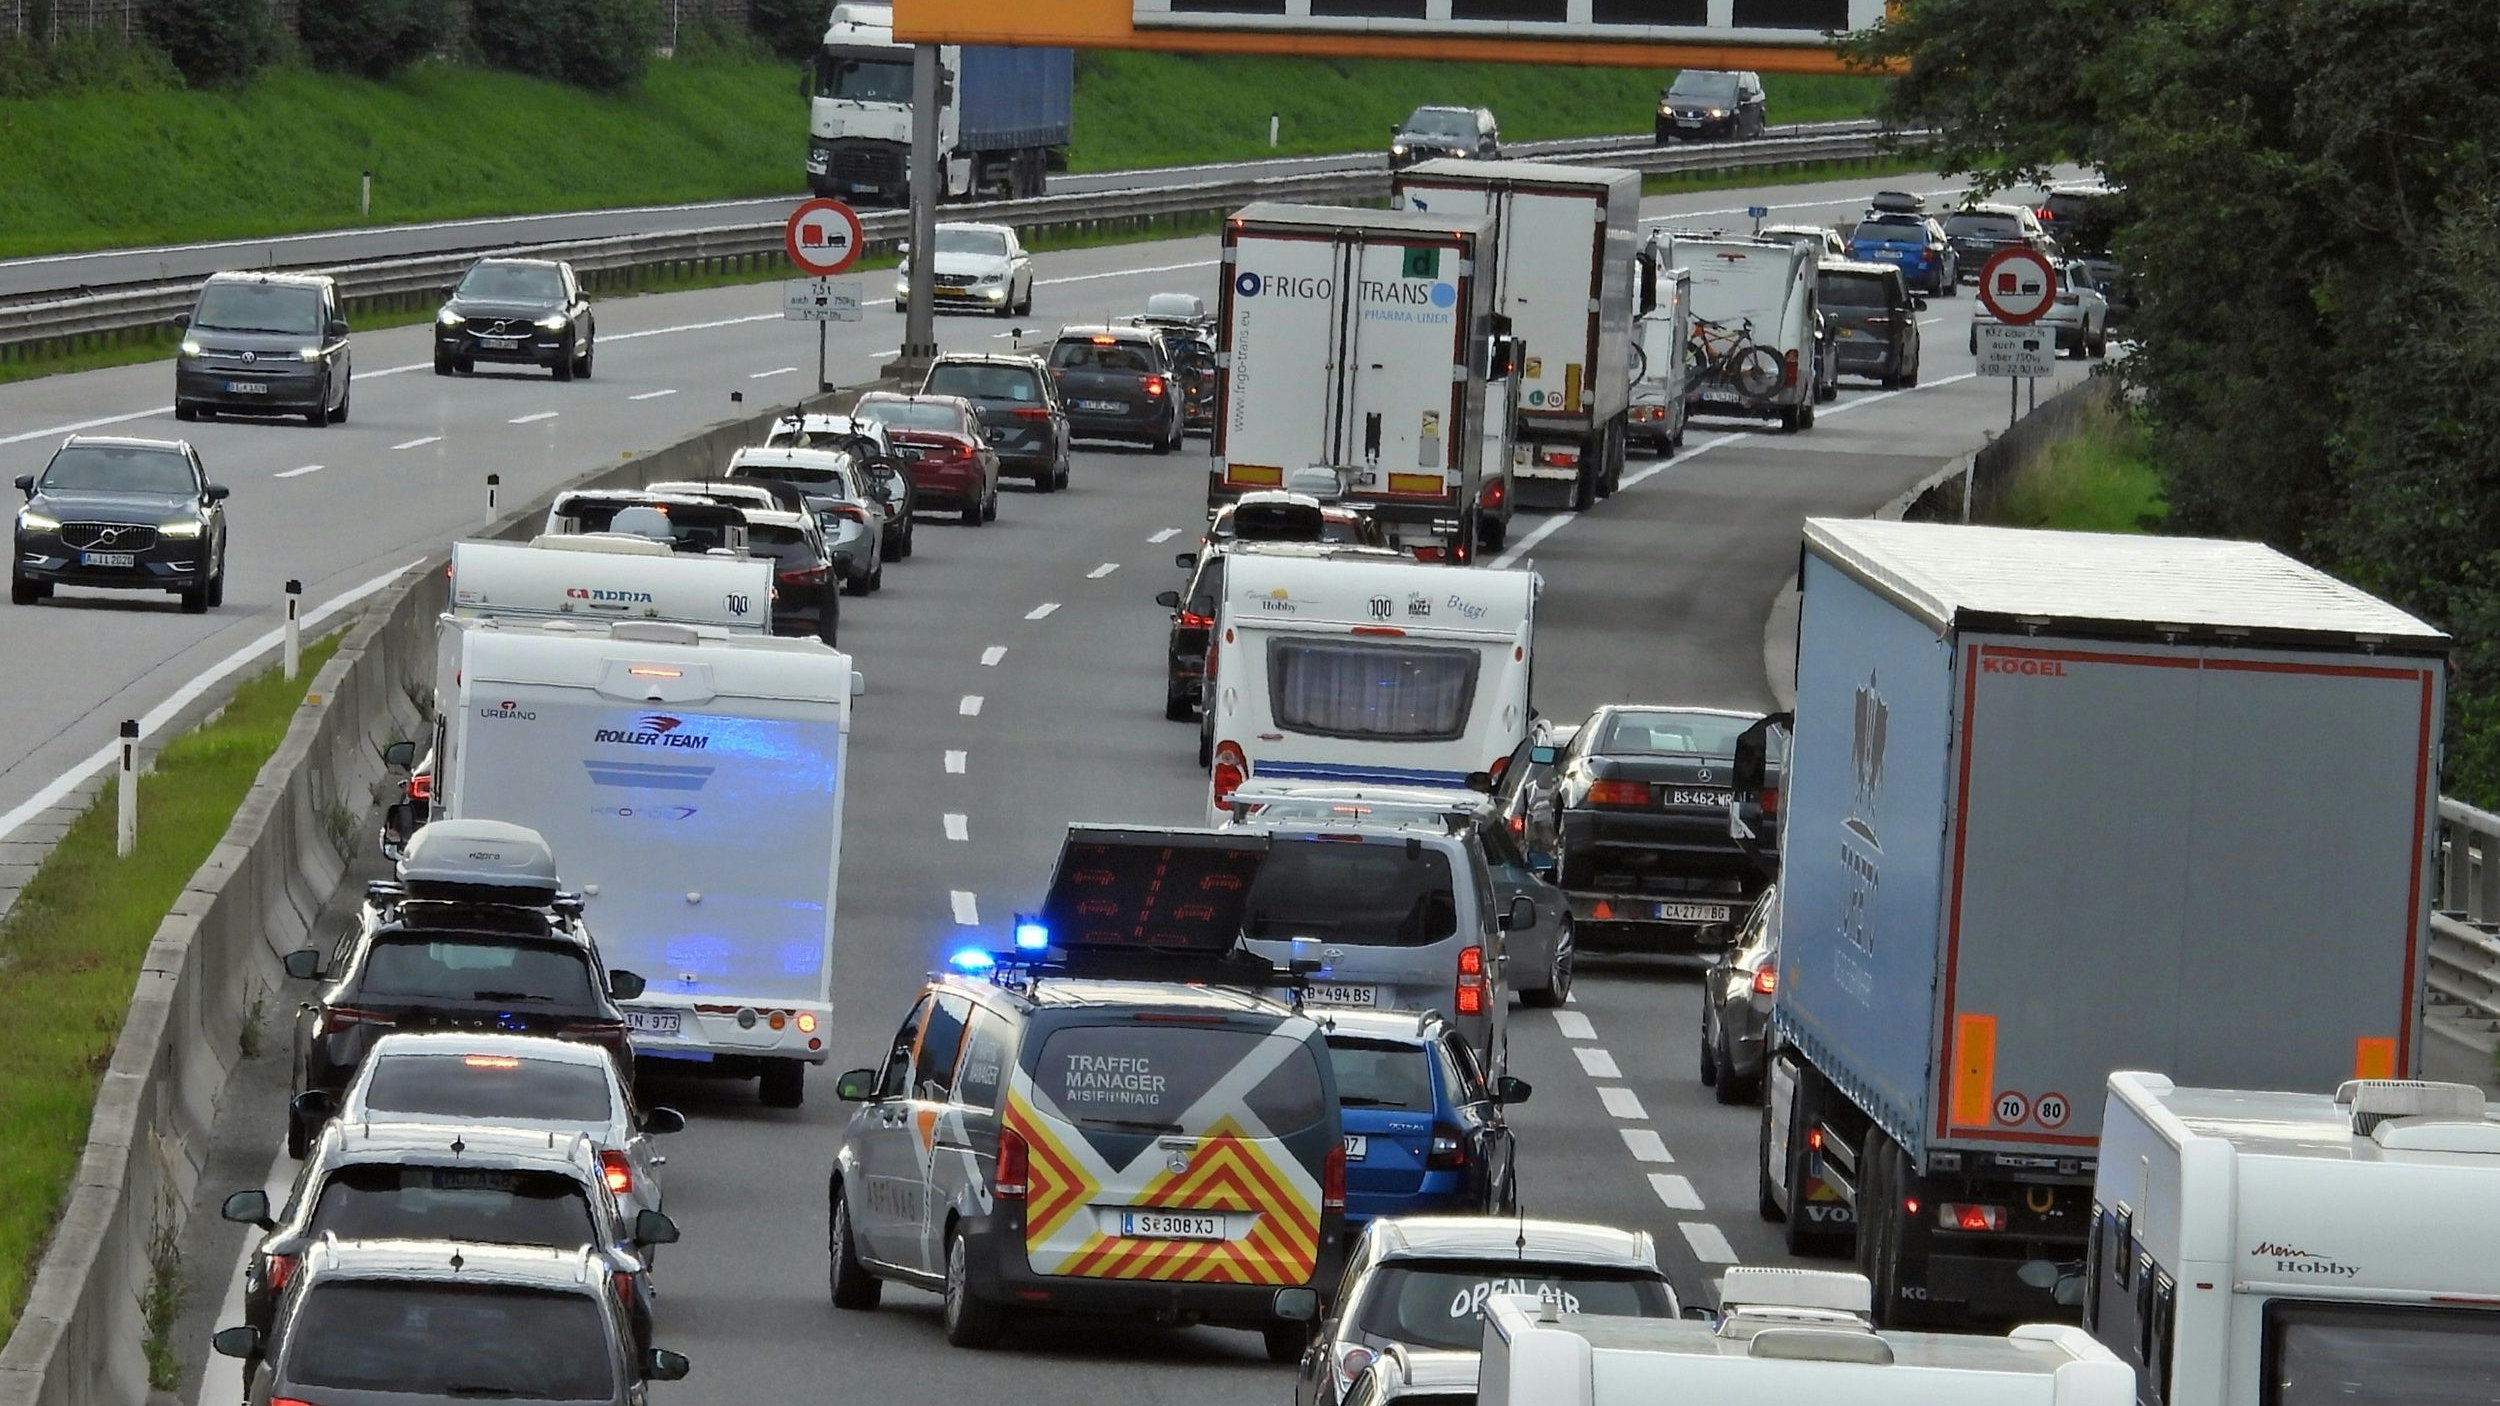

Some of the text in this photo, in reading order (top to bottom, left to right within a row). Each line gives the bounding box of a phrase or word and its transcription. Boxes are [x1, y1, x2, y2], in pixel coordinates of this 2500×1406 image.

[1262, 275, 1429, 305] FRIGO TRANS
[1233, 310, 1250, 433] www.frigo-trans.eu
[592, 590, 653, 603] ADRIA
[727, 594, 748, 616] 100
[1262, 600, 1298, 614] Hobby
[1370, 599, 1392, 617] 100
[481, 708, 537, 721] URBANO
[594, 729, 709, 749] ROLLER TEAM
[1066, 1054, 1150, 1073] TRAFFIC
[1065, 1072, 1166, 1092] MANAGER
[2002, 1101, 2020, 1117] 70
[2042, 1102, 2061, 1119] 80
[2276, 1260, 2362, 1279] Hobby
